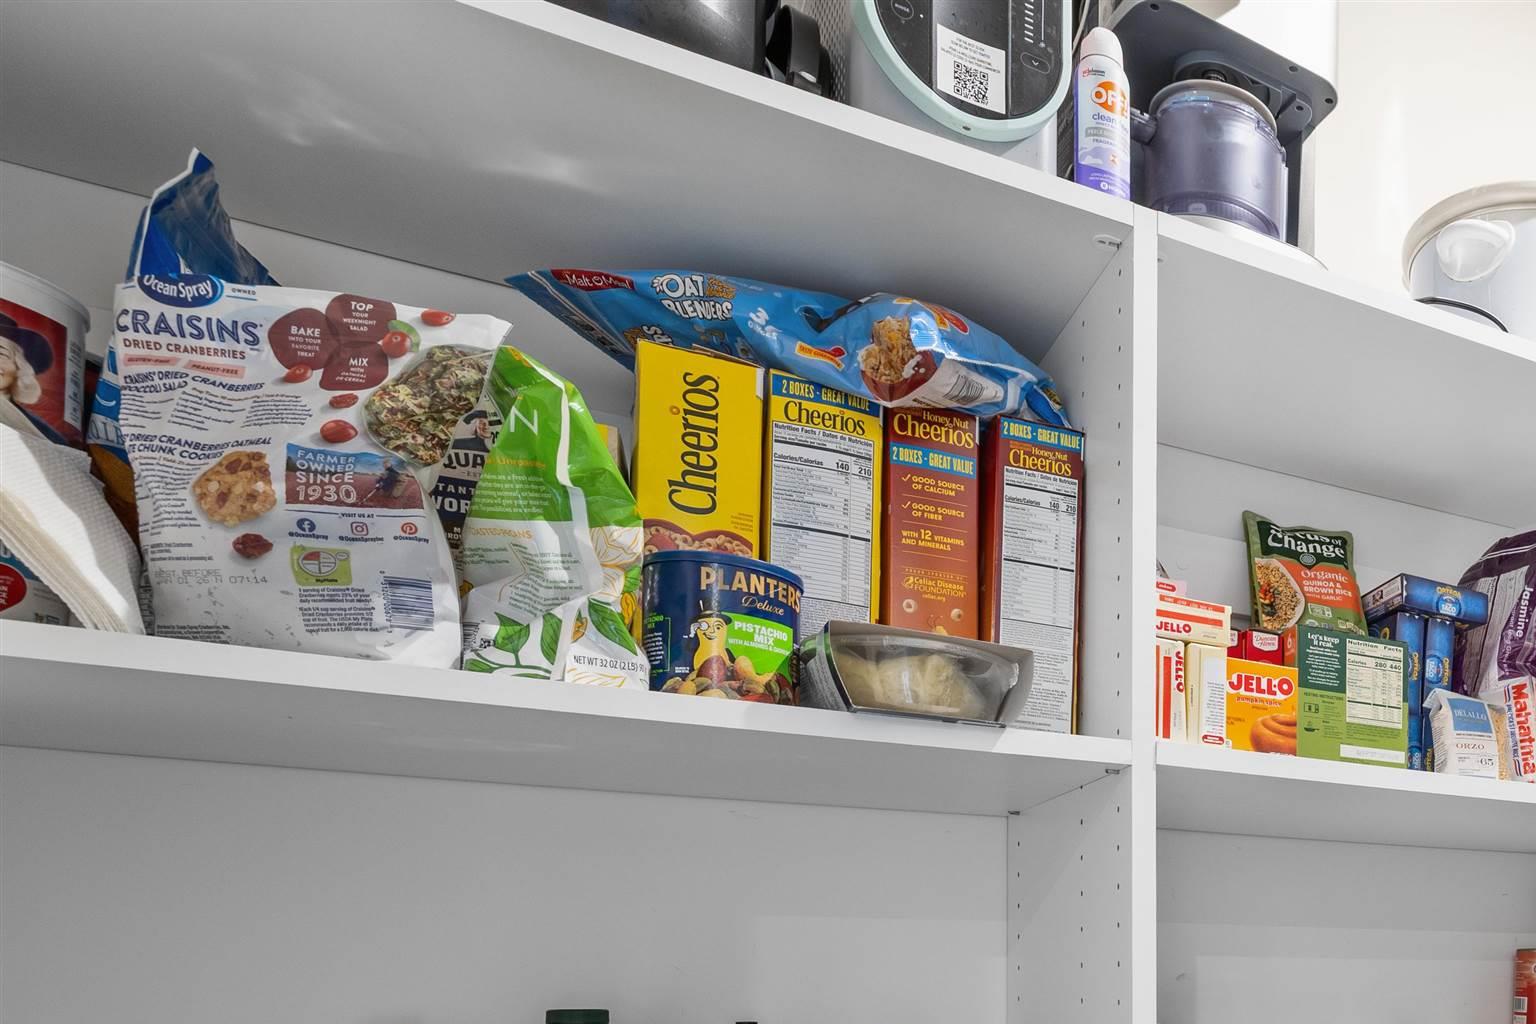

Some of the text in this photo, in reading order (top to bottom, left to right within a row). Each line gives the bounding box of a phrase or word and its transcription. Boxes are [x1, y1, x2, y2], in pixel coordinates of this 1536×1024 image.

[178, 279, 212, 301] Spray
[350, 301, 373, 312] TOP
[661, 299, 733, 321] BLENDERS
[116, 308, 260, 347] CRAISINS
[290, 325, 321, 337] BAKE
[122, 338, 246, 361] DRIED CRANBERRIES
[350, 357, 369, 368] MIX
[789, 381, 815, 399] BOXES
[784, 400, 866, 436] Cheerios
[922, 410, 969, 430] Honey Nut
[893, 413, 974, 449] Cheerios
[667, 371, 721, 516] Cheerios
[297, 450, 356, 464] FARMER
[899, 451, 950, 469] BOXES GREAT
[1009, 449, 1072, 477] Cheerios
[296, 460, 355, 473] OWNED
[835, 461, 850, 471] 140
[858, 467, 872, 477] 210
[296, 470, 355, 485] SINCE
[911, 476, 965, 491] GOOD SOURCE
[296, 484, 357, 503] 1930
[924, 485, 956, 497] CALCIUM
[911, 503, 965, 518] GOOD SOURCE
[924, 512, 943, 521] FIBER
[918, 539, 951, 551] MINERALS
[920, 529, 965, 546] 12 VITAMINS
[1267, 533, 1345, 558] Change
[1301, 569, 1348, 583] Organic
[700, 566, 800, 614] PLANTERS
[1303, 580, 1334, 589] QUINOA
[1304, 586, 1331, 595] BROWN
[742, 595, 784, 616] Deluxe
[1516, 584, 1534, 638] Jasmine
[734, 621, 788, 641] PISTACHIO
[754, 633, 774, 646] MIX
[1347, 640, 1378, 649] Nutrition
[1453, 709, 1487, 721] DELALLO
[1511, 683, 1536, 775] Mahatma
[1456, 742, 1485, 750] ORZO
